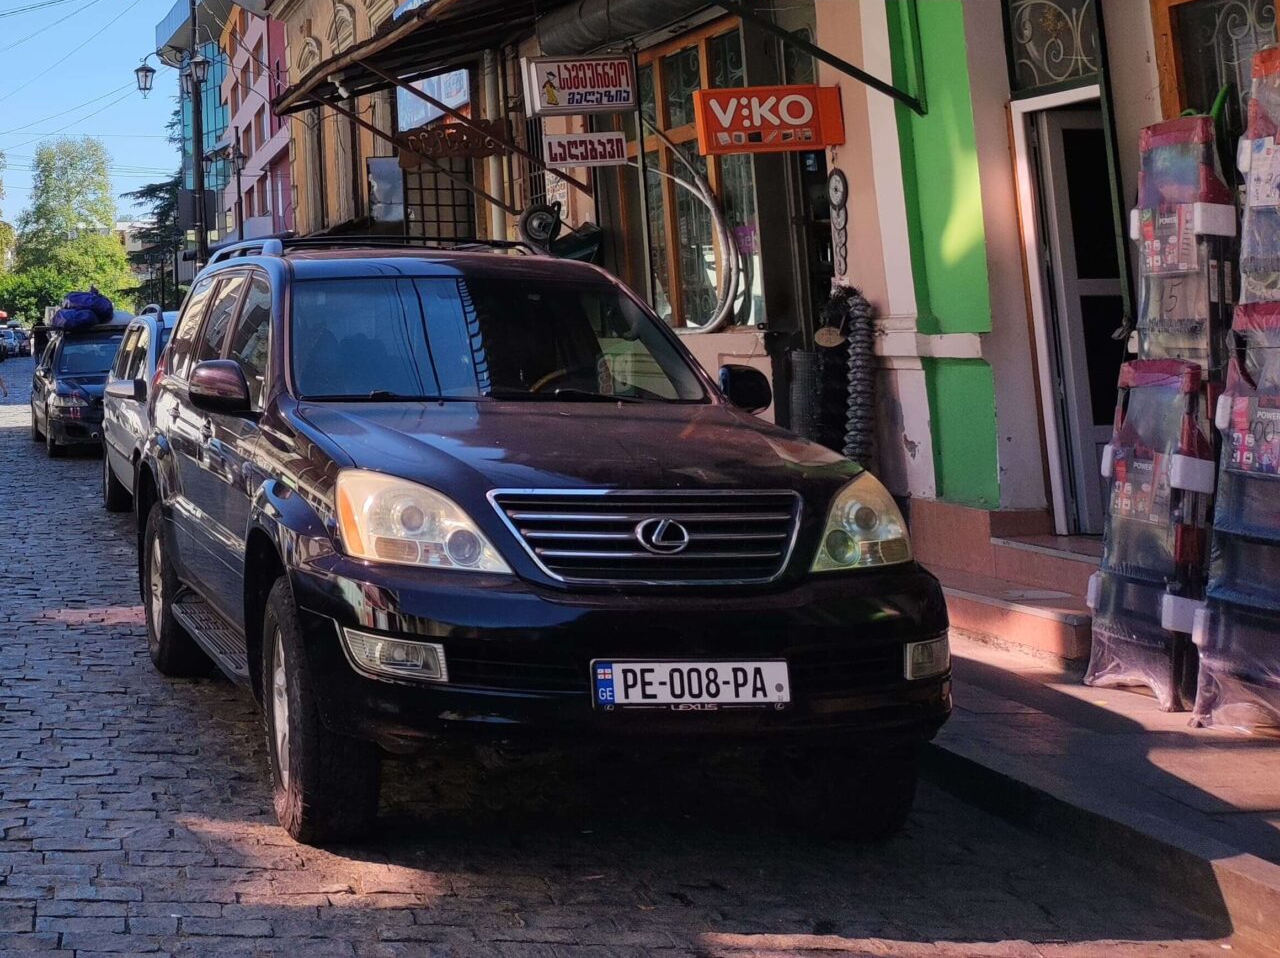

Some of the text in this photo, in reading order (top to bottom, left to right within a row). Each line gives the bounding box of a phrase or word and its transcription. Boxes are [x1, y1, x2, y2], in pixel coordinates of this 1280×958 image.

[556, 61, 630, 91] სამეურნეო
[547, 137, 625, 162] საღებავი
[598, 687, 613, 701] GE
[621, 666, 768, 700] PE-008-PA
[670, 703, 719, 711] LEXUS
